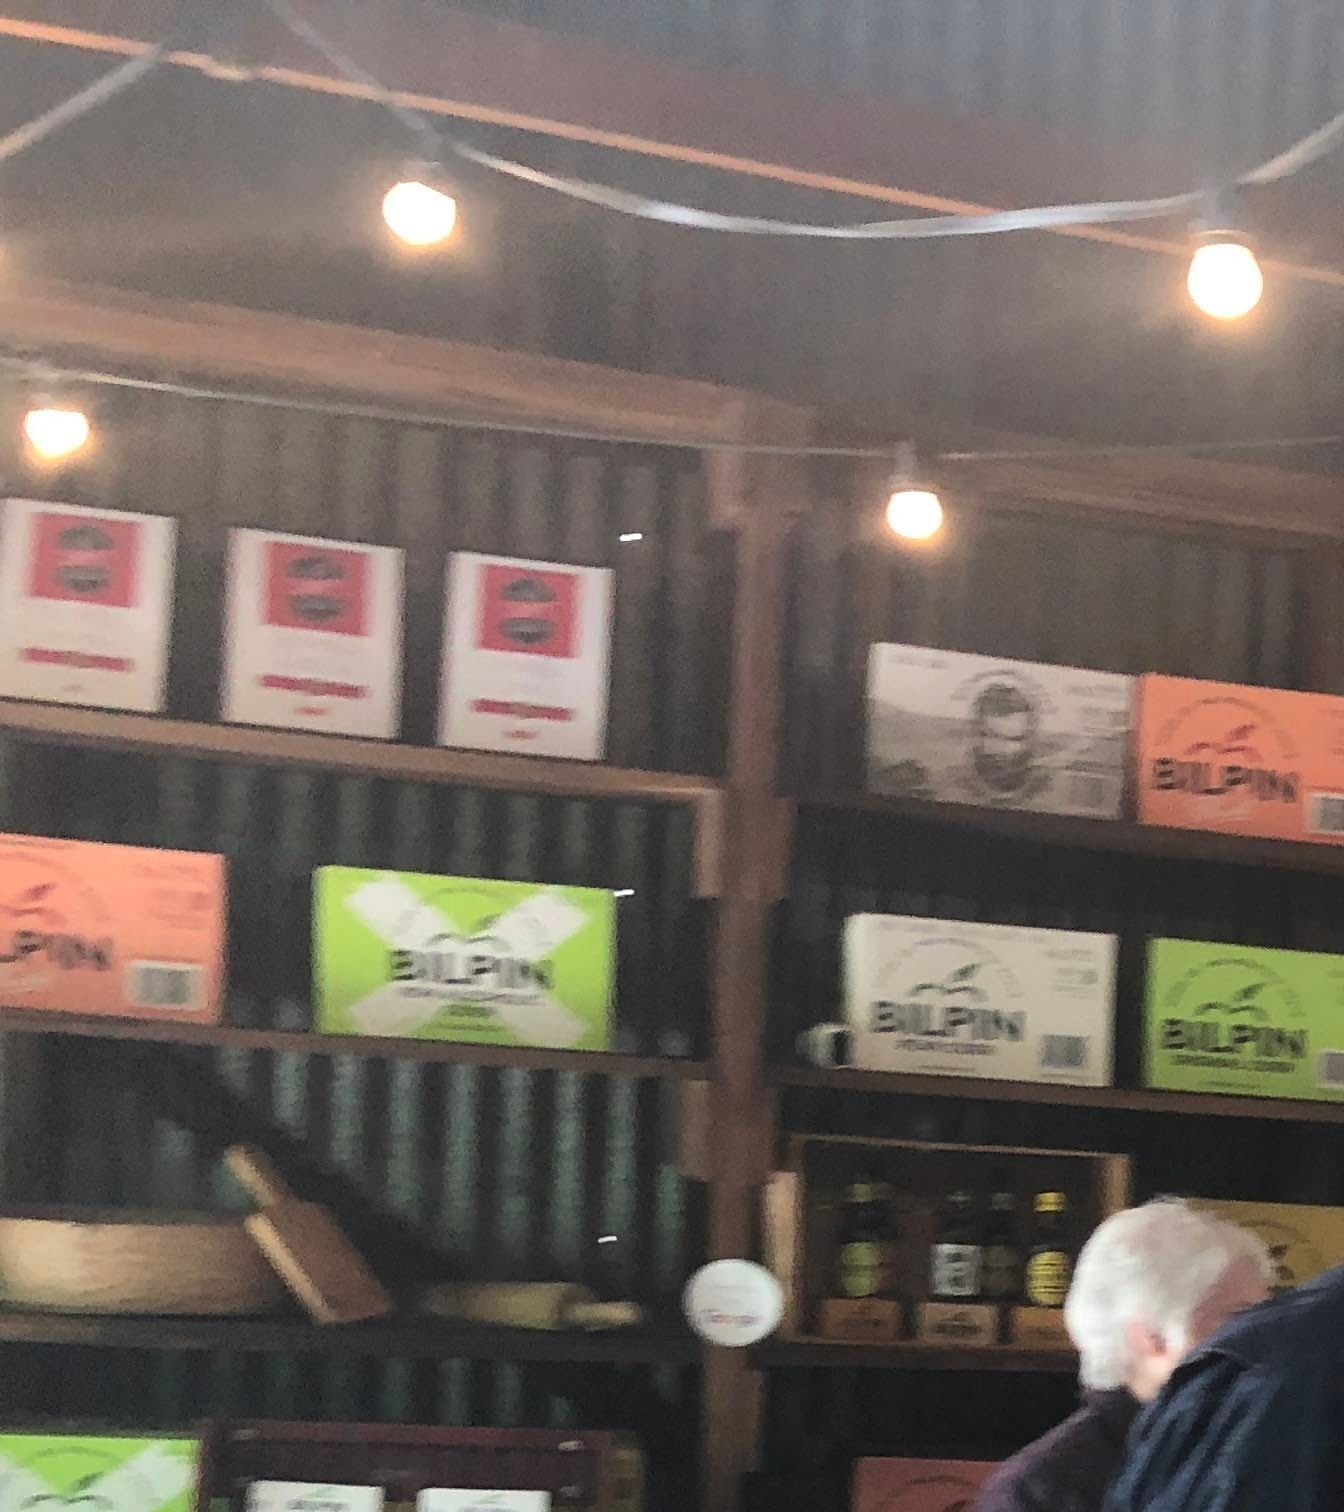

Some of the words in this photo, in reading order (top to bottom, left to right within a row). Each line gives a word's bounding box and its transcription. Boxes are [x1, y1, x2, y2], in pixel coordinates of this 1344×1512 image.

[1151, 756, 1300, 803] BILPIN
[386, 949, 556, 990] BILPIN
[870, 1001, 1027, 1041] BILPIN
[1162, 1018, 1309, 1058] BILPIN
